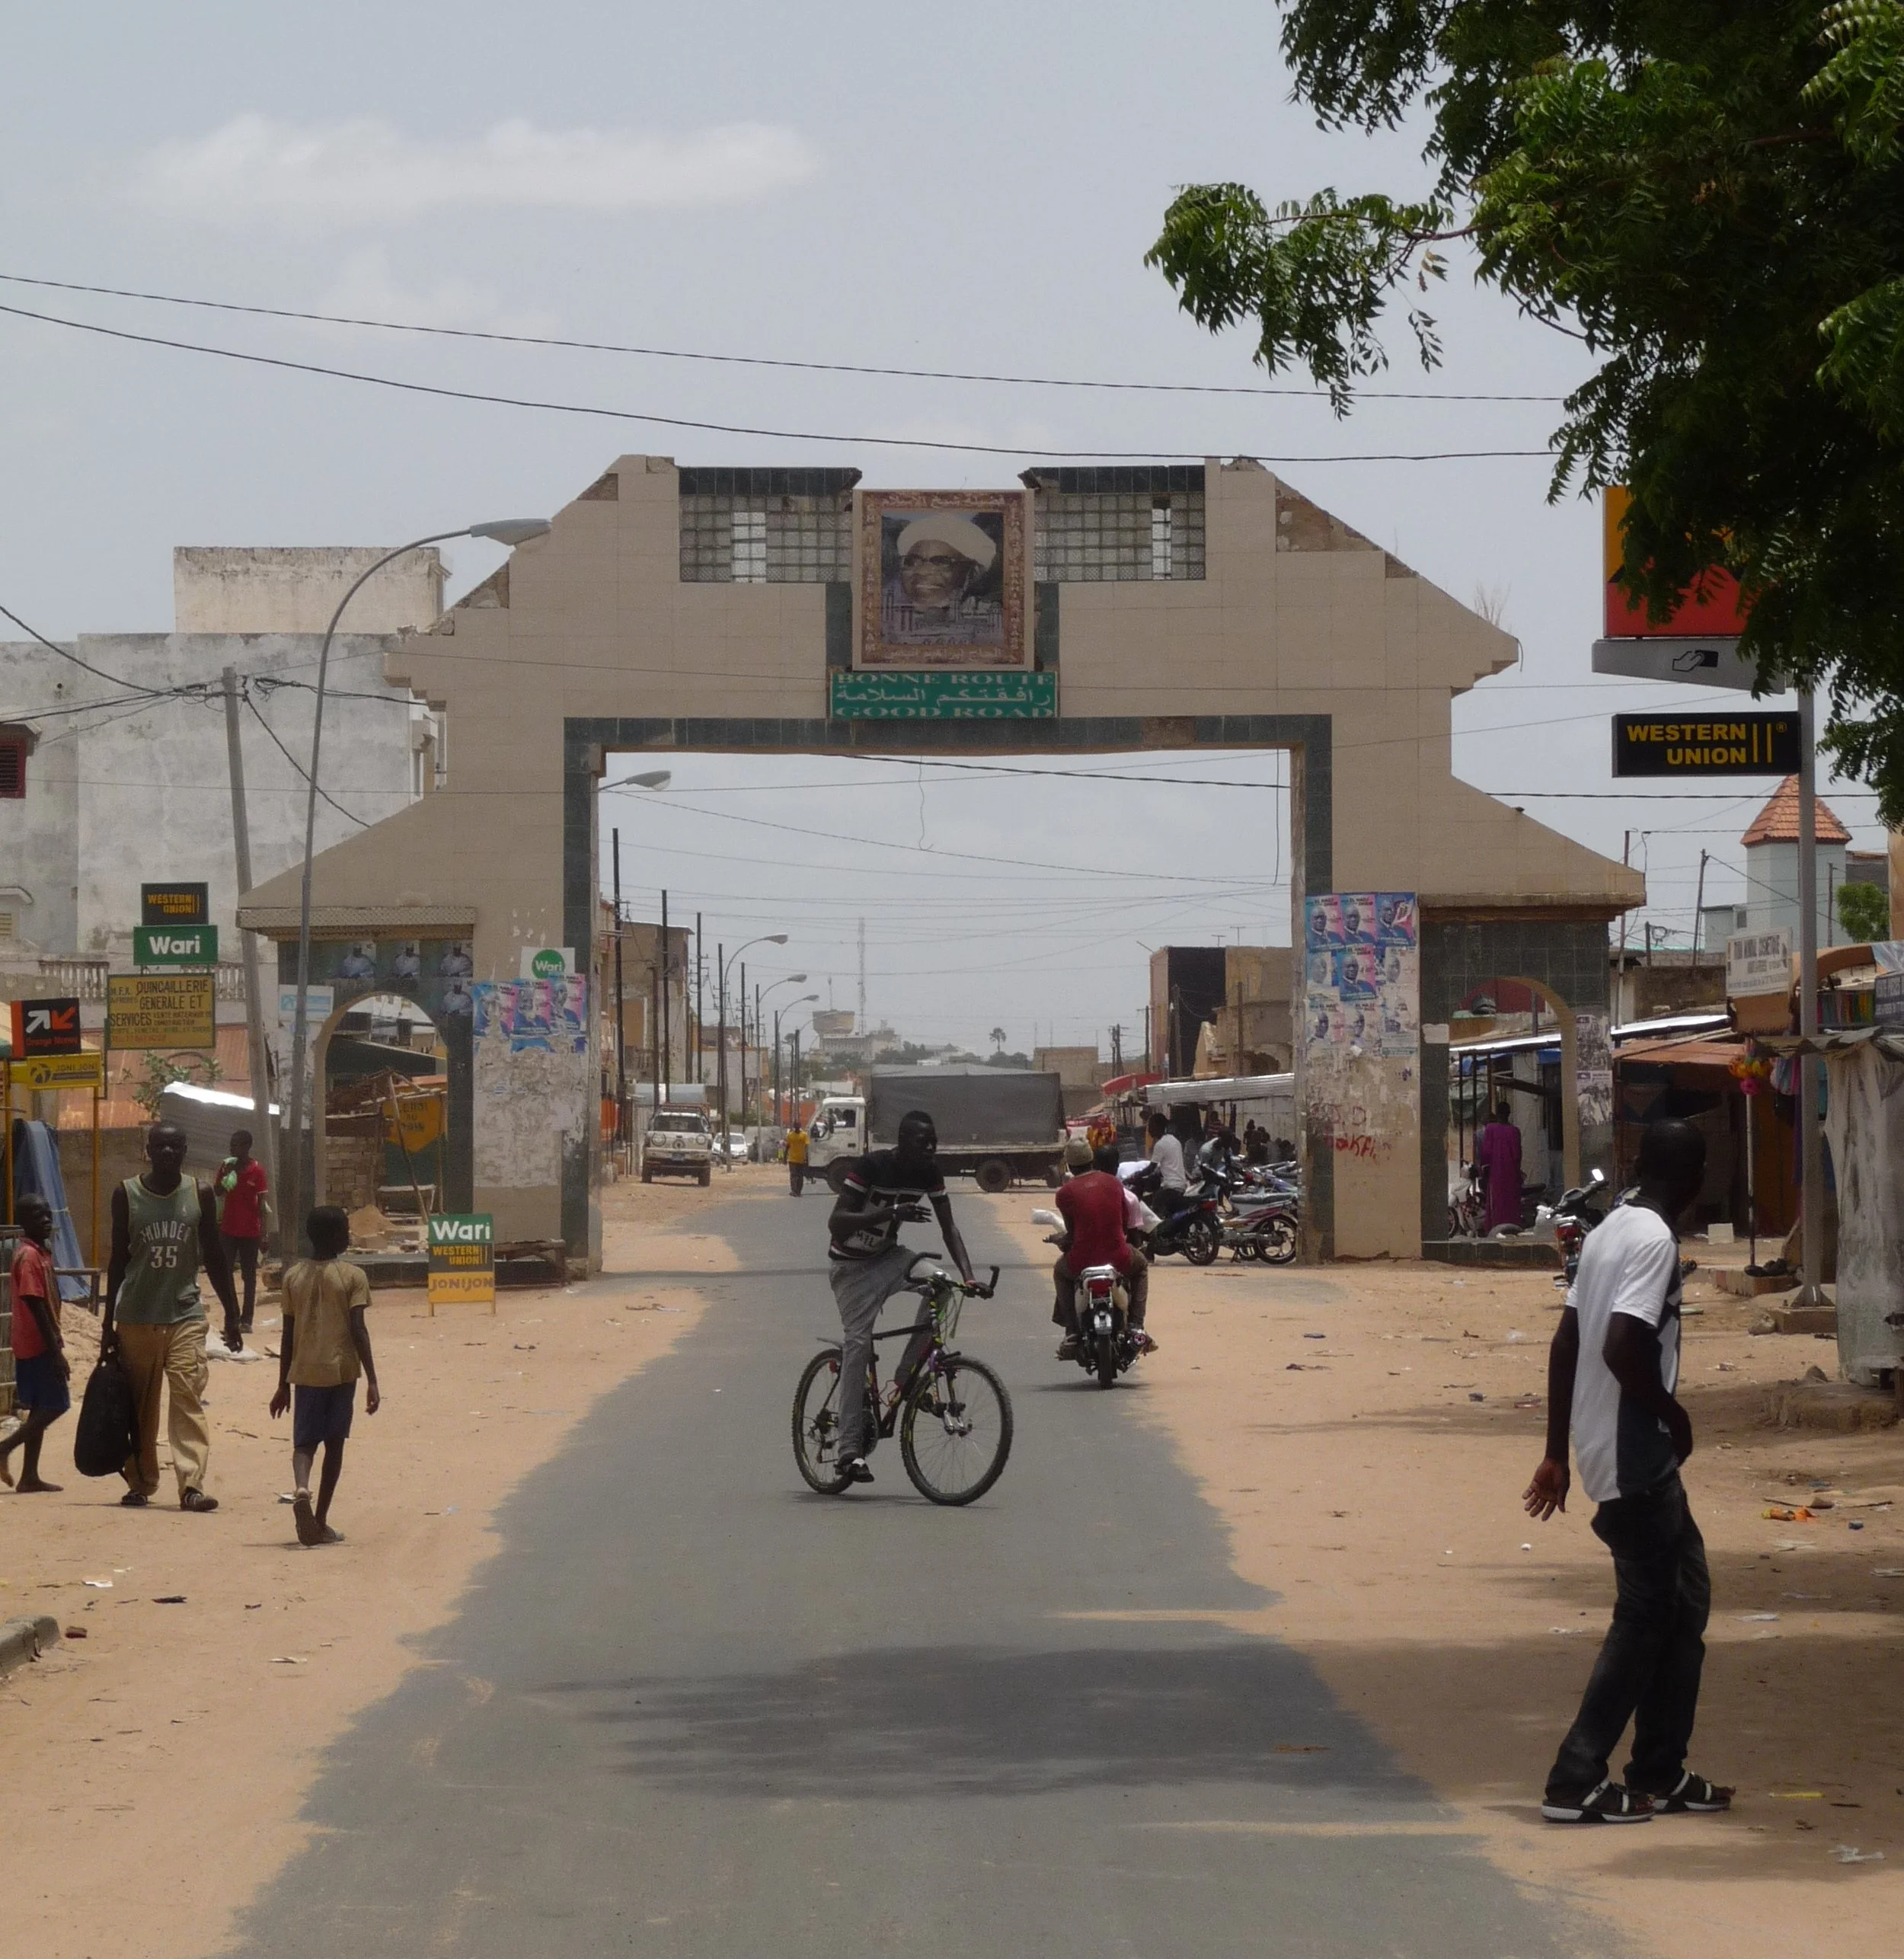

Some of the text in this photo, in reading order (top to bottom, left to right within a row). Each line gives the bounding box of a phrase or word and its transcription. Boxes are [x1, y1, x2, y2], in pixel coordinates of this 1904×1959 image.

[838, 673, 1053, 685] BONNE ROUTE
[836, 685, 926, 701] السلامة
[835, 707, 1054, 717] GOOD ROAD
[1627, 724, 1746, 743] WESTERN
[1666, 748, 1746, 765] UNION
[147, 894, 191, 904] WESTERN
[163, 904, 191, 913] UNION
[149, 935, 200, 954] Wari
[535, 960, 562, 972] Wari
[136, 980, 209, 995] QUINCAILLERIE
[139, 995, 184, 1010] GENERALE
[190, 995, 203, 1008] ET
[110, 1012, 152, 1027] SERVICES
[432, 1221, 490, 1240] Wari
[151, 1245, 177, 1268] 35
[433, 1245, 479, 1255] WESTERN
[449, 1255, 479, 1265] UNION
